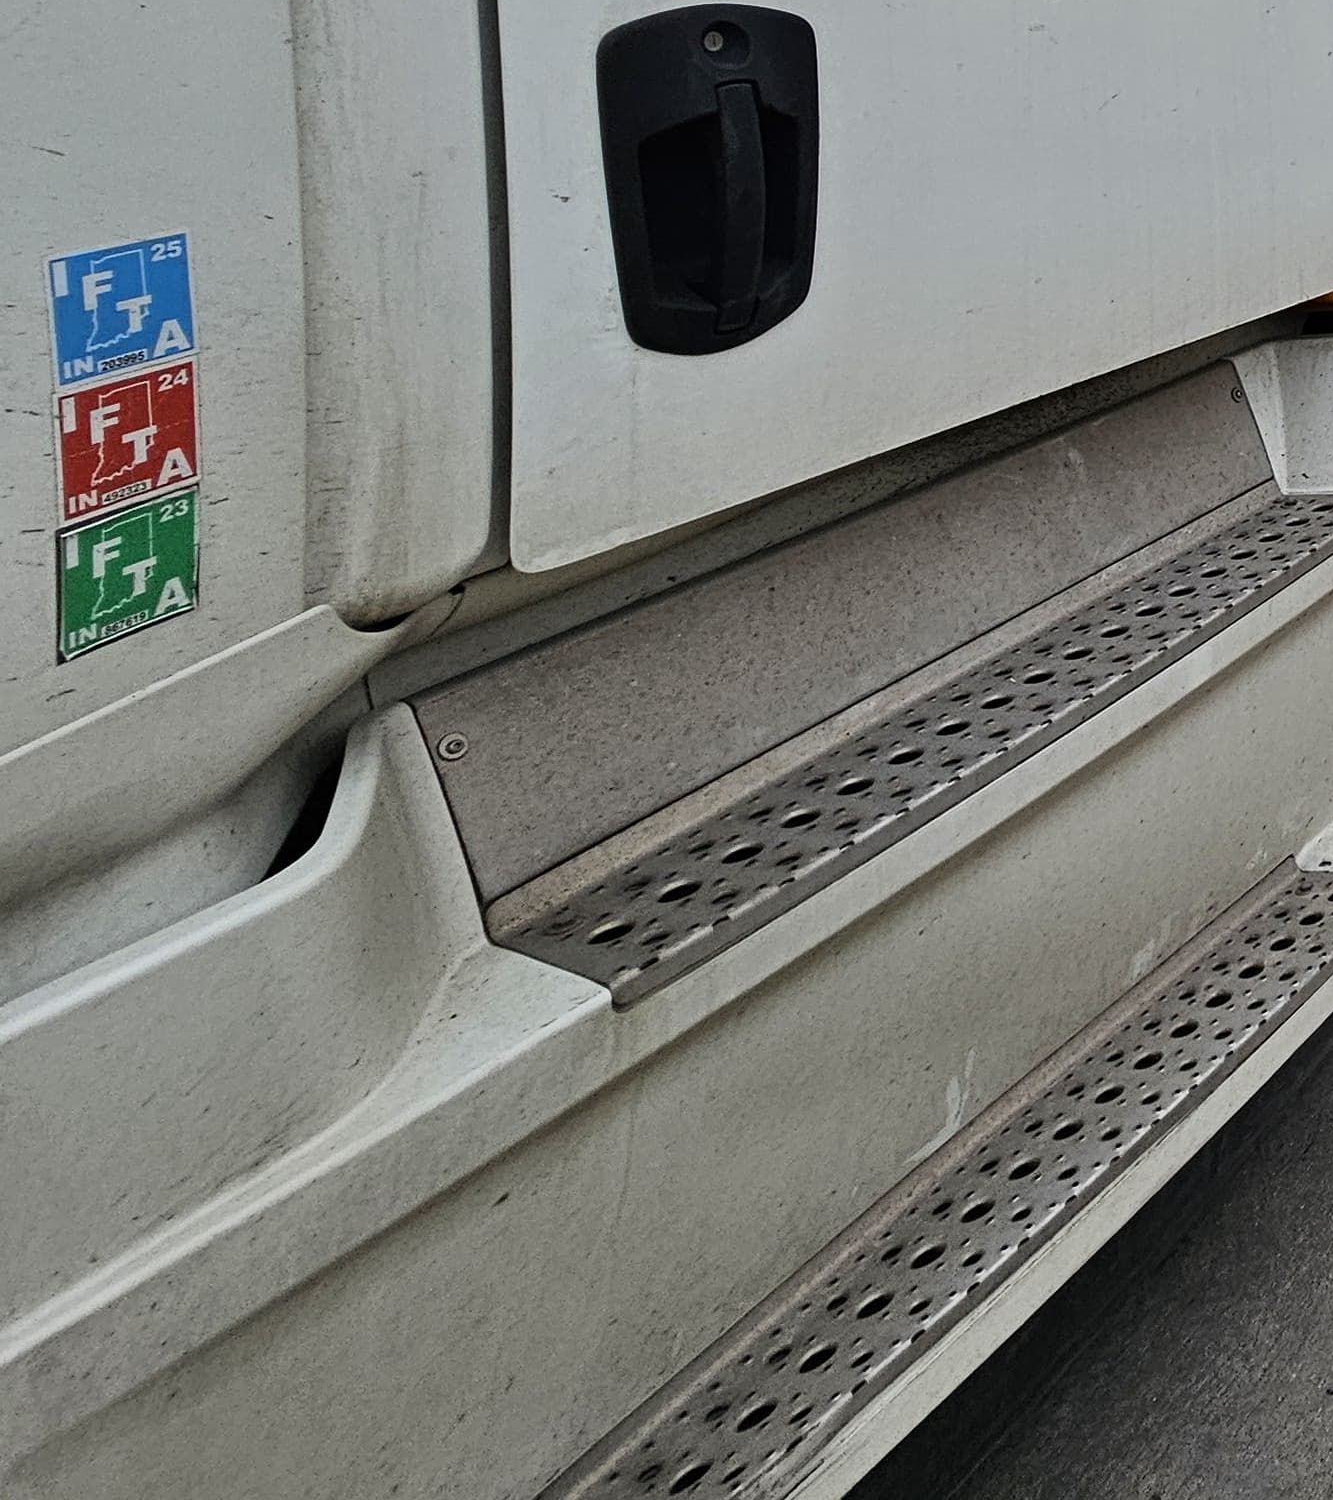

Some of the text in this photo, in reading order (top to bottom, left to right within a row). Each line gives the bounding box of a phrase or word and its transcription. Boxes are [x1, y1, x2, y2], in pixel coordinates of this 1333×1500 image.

[151, 240, 182, 262] 25
[63, 355, 94, 380] IN
[157, 368, 189, 393] 24
[68, 489, 98, 514] IN
[159, 499, 189, 523] 23
[68, 623, 97, 649] IN
